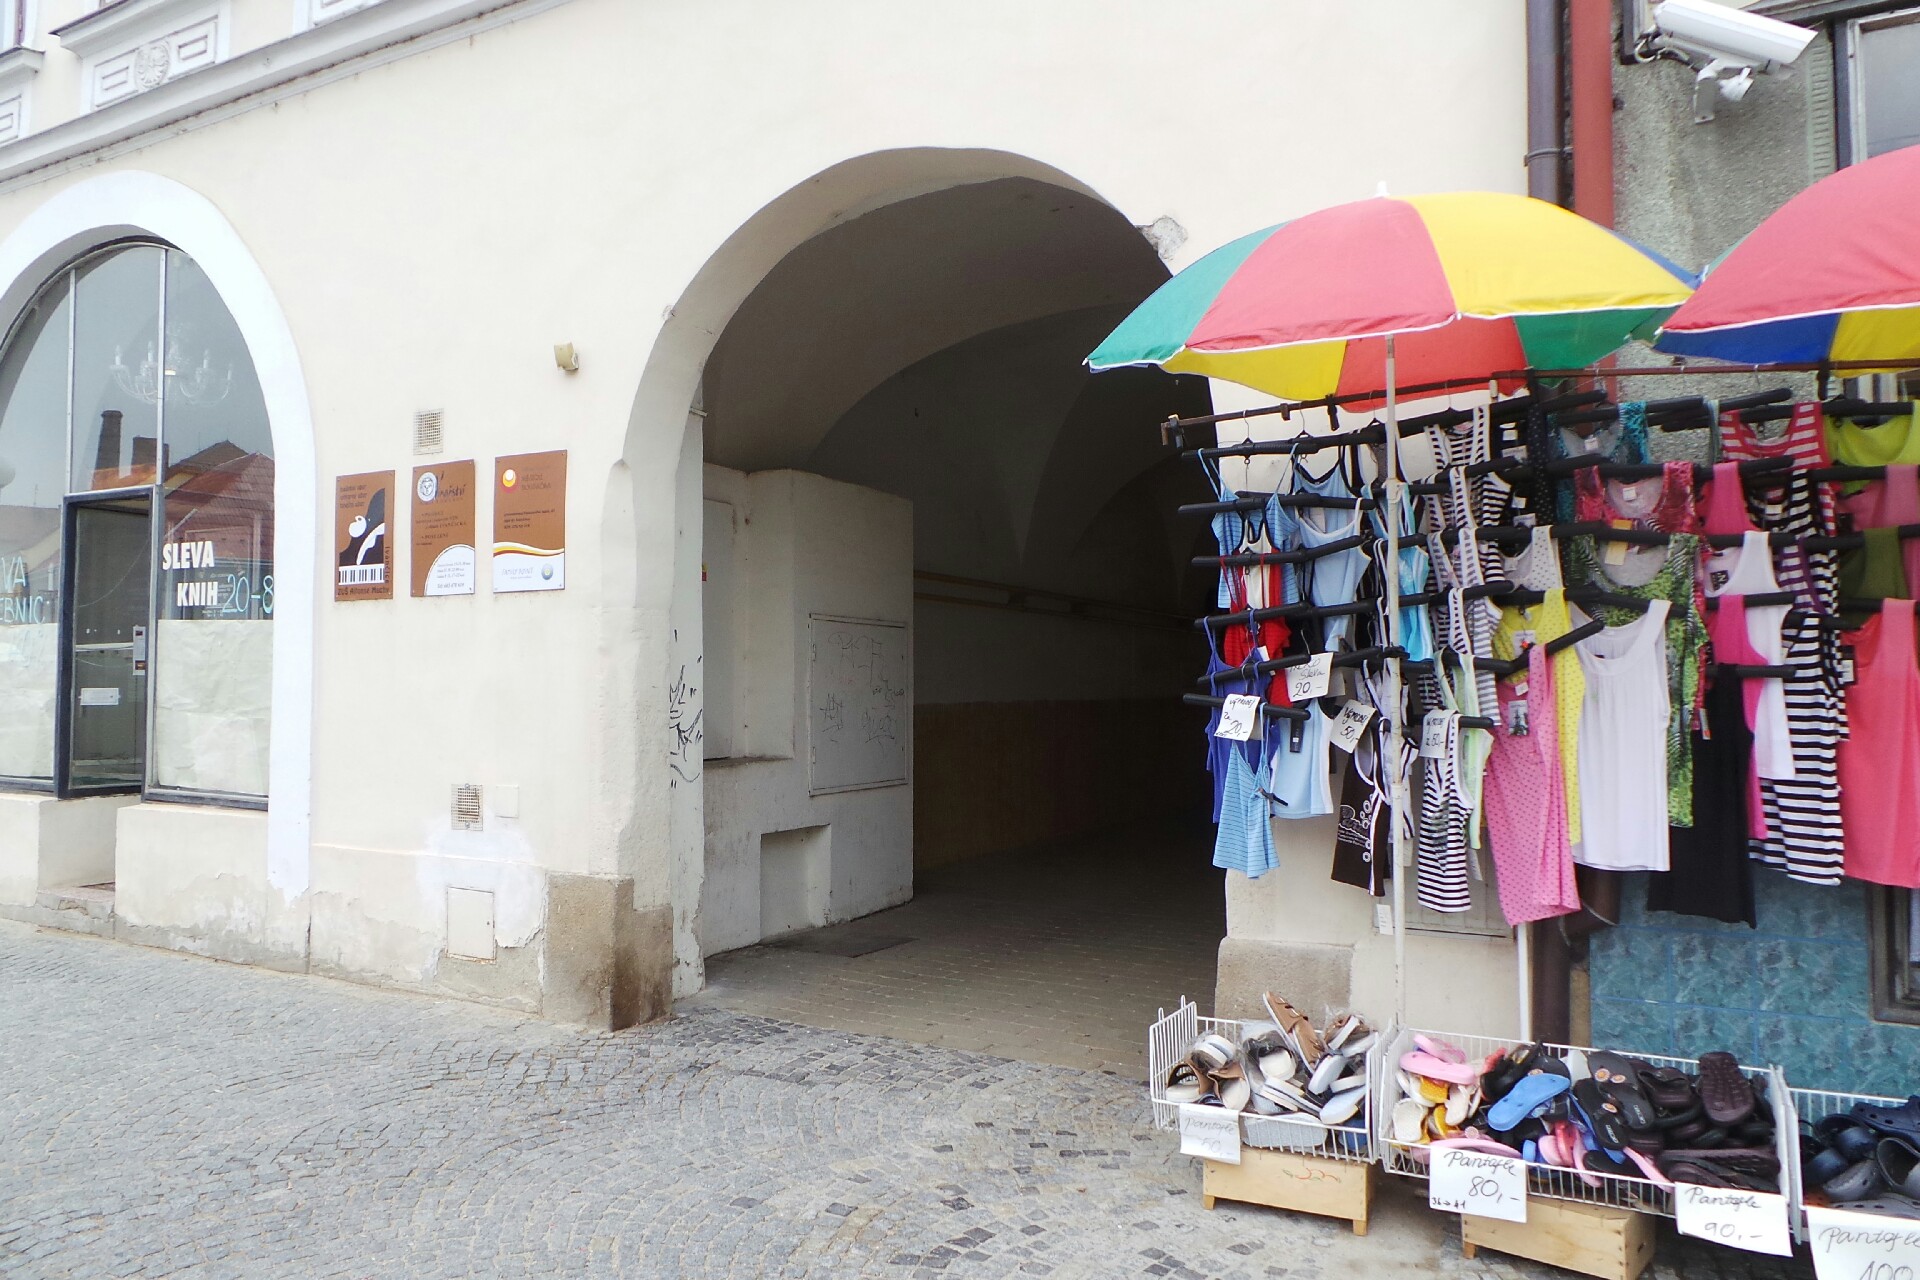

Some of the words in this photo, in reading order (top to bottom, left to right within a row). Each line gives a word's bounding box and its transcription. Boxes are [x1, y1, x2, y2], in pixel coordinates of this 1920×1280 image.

[162, 540, 215, 571] SLEVA
[1, 555, 26, 594] VA
[177, 581, 218, 607] KNIH
